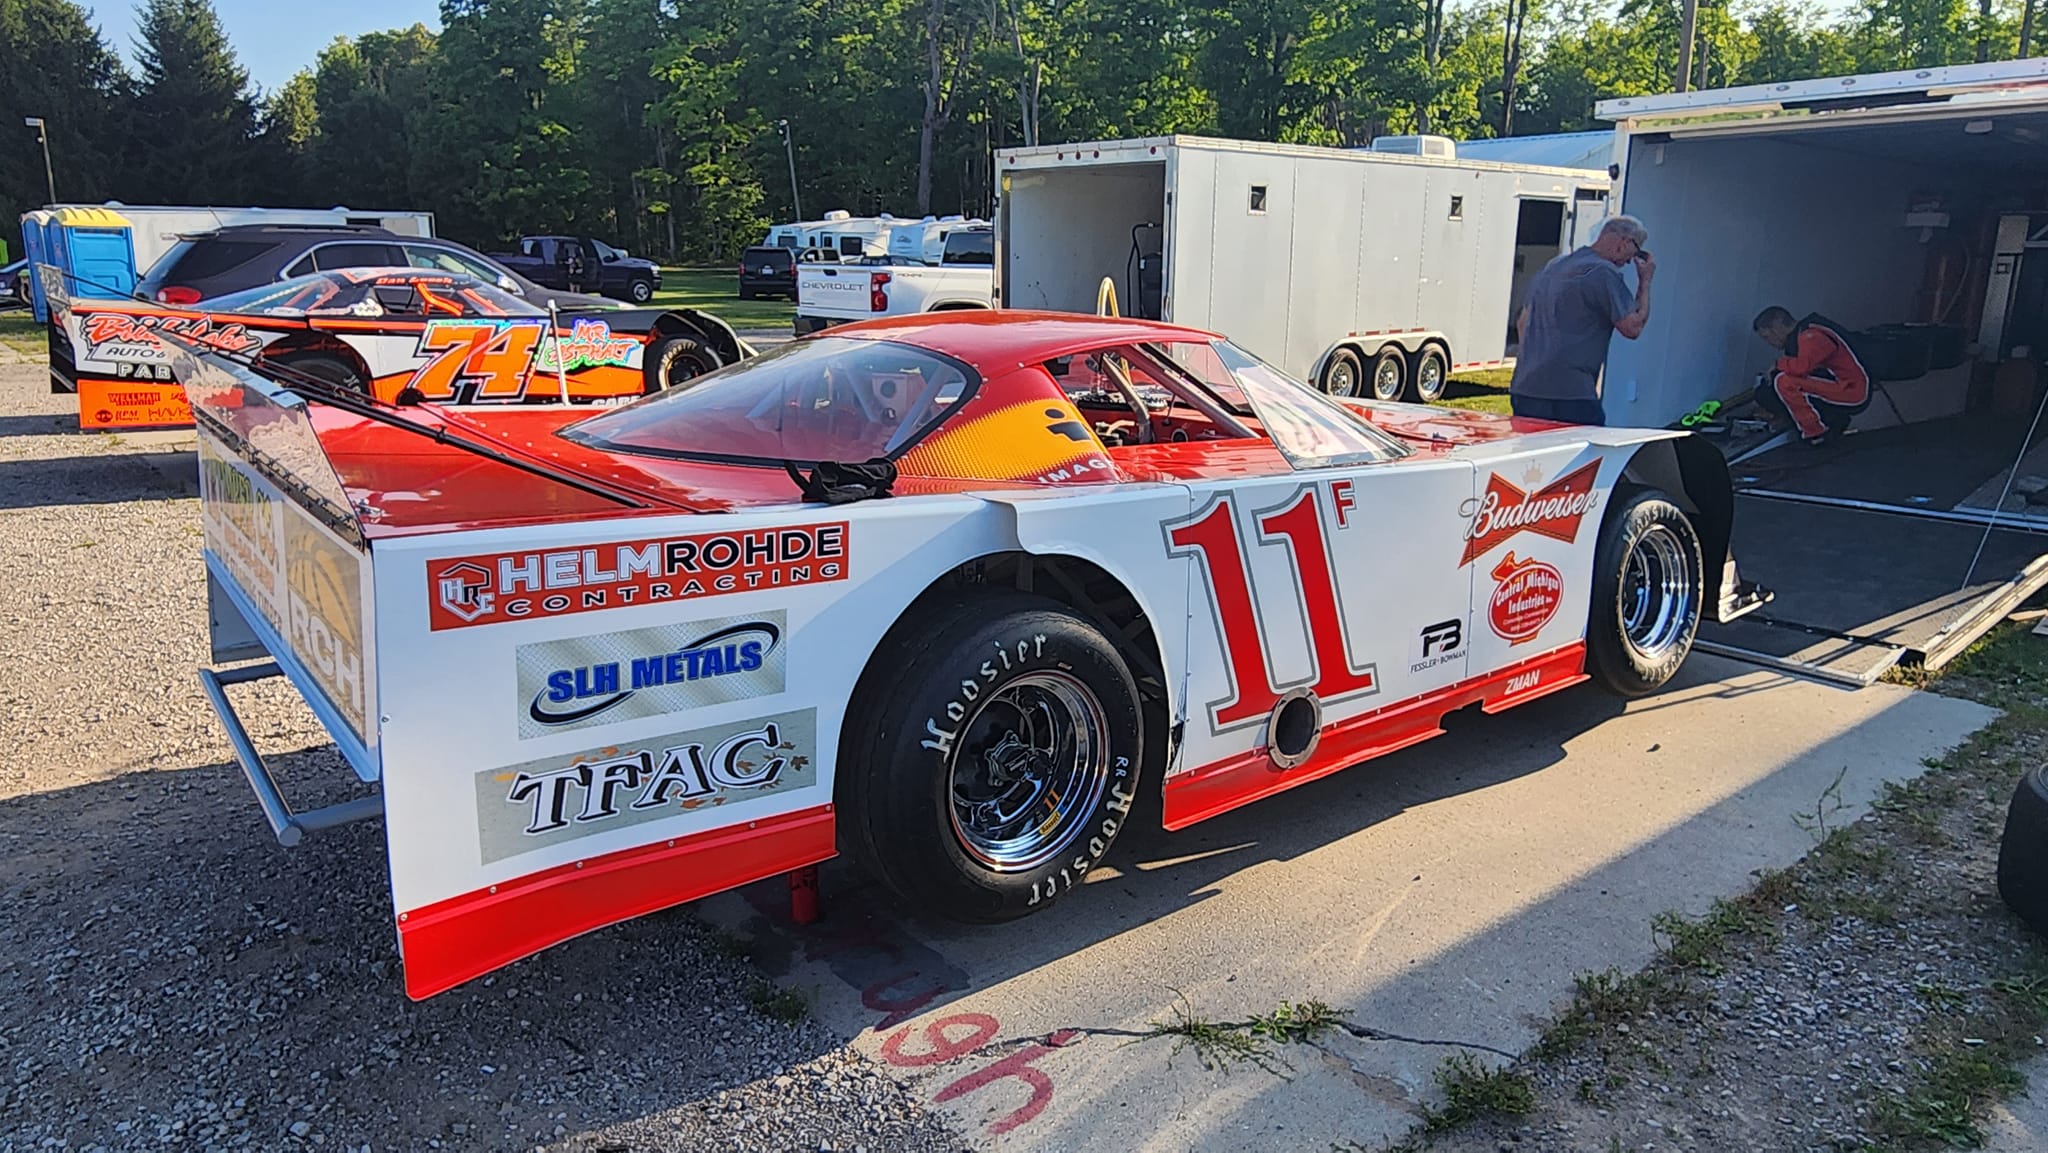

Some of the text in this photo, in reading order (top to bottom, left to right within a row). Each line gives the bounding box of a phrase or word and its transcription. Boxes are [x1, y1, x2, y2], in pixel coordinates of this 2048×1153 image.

[802, 281, 864, 291] CHEVROLET
[576, 322, 606, 341] MR
[107, 346, 155, 358] AUTO
[411, 322, 545, 403] 74
[549, 341, 634, 362] ASPHALT
[117, 362, 170, 379] PAR
[107, 391, 160, 403] WELLMAN
[1038, 458, 1113, 484] IMAG
[1458, 483, 1599, 542] Budweiser
[505, 562, 842, 618] CONTRACTING
[1495, 570, 1560, 607] Central Michigan
[1508, 592, 1545, 616] Industries
[1159, 477, 1381, 737] 11 F
[289, 586, 362, 716] RCH
[546, 640, 764, 704] SLH METALS
[1503, 669, 1541, 696] ZMAN
[920, 632, 1048, 765] Hoosier
[506, 722, 789, 837] TFAC
[1114, 755, 1130, 778] RR
[1026, 781, 1136, 907] Hoosier
